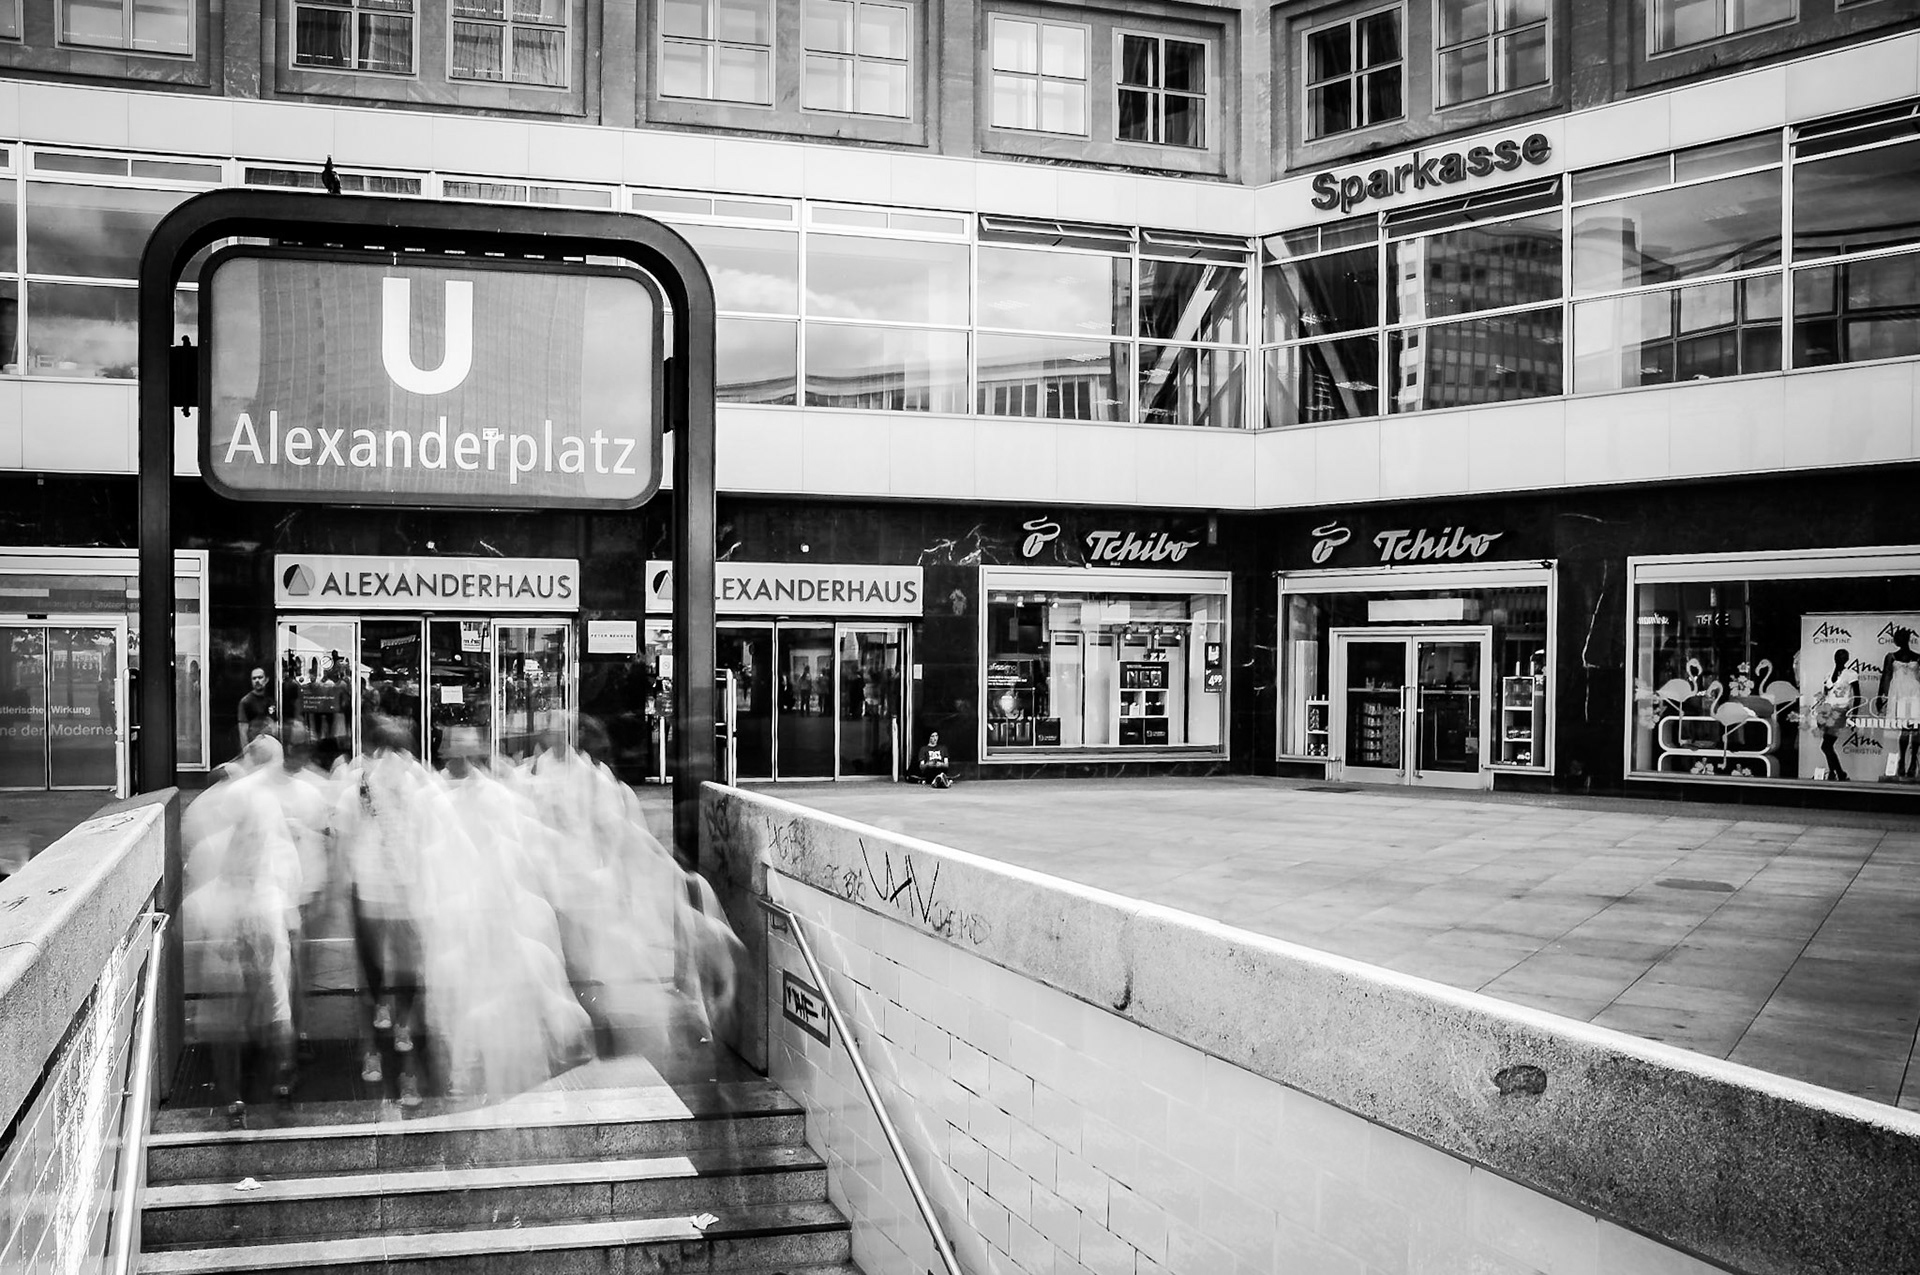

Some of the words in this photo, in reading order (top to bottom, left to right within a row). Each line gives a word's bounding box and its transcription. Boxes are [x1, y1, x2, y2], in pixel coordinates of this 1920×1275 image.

[1311, 133, 1552, 213] Sparkasse
[382, 277, 474, 395] U
[224, 410, 637, 485] Alexanderplatz
[1085, 530, 1200, 562] Tchibo
[1372, 526, 1504, 562] Tchibo
[320, 572, 572, 599] ALEXANDERHAUS
[715, 577, 918, 603] EXANDERHAUS
[1812, 621, 1852, 637] Ann
[51, 705, 91, 716] Wirkung
[21, 724, 45, 736] der
[51, 724, 113, 736] Moderne
[1842, 732, 1883, 749] Ann
